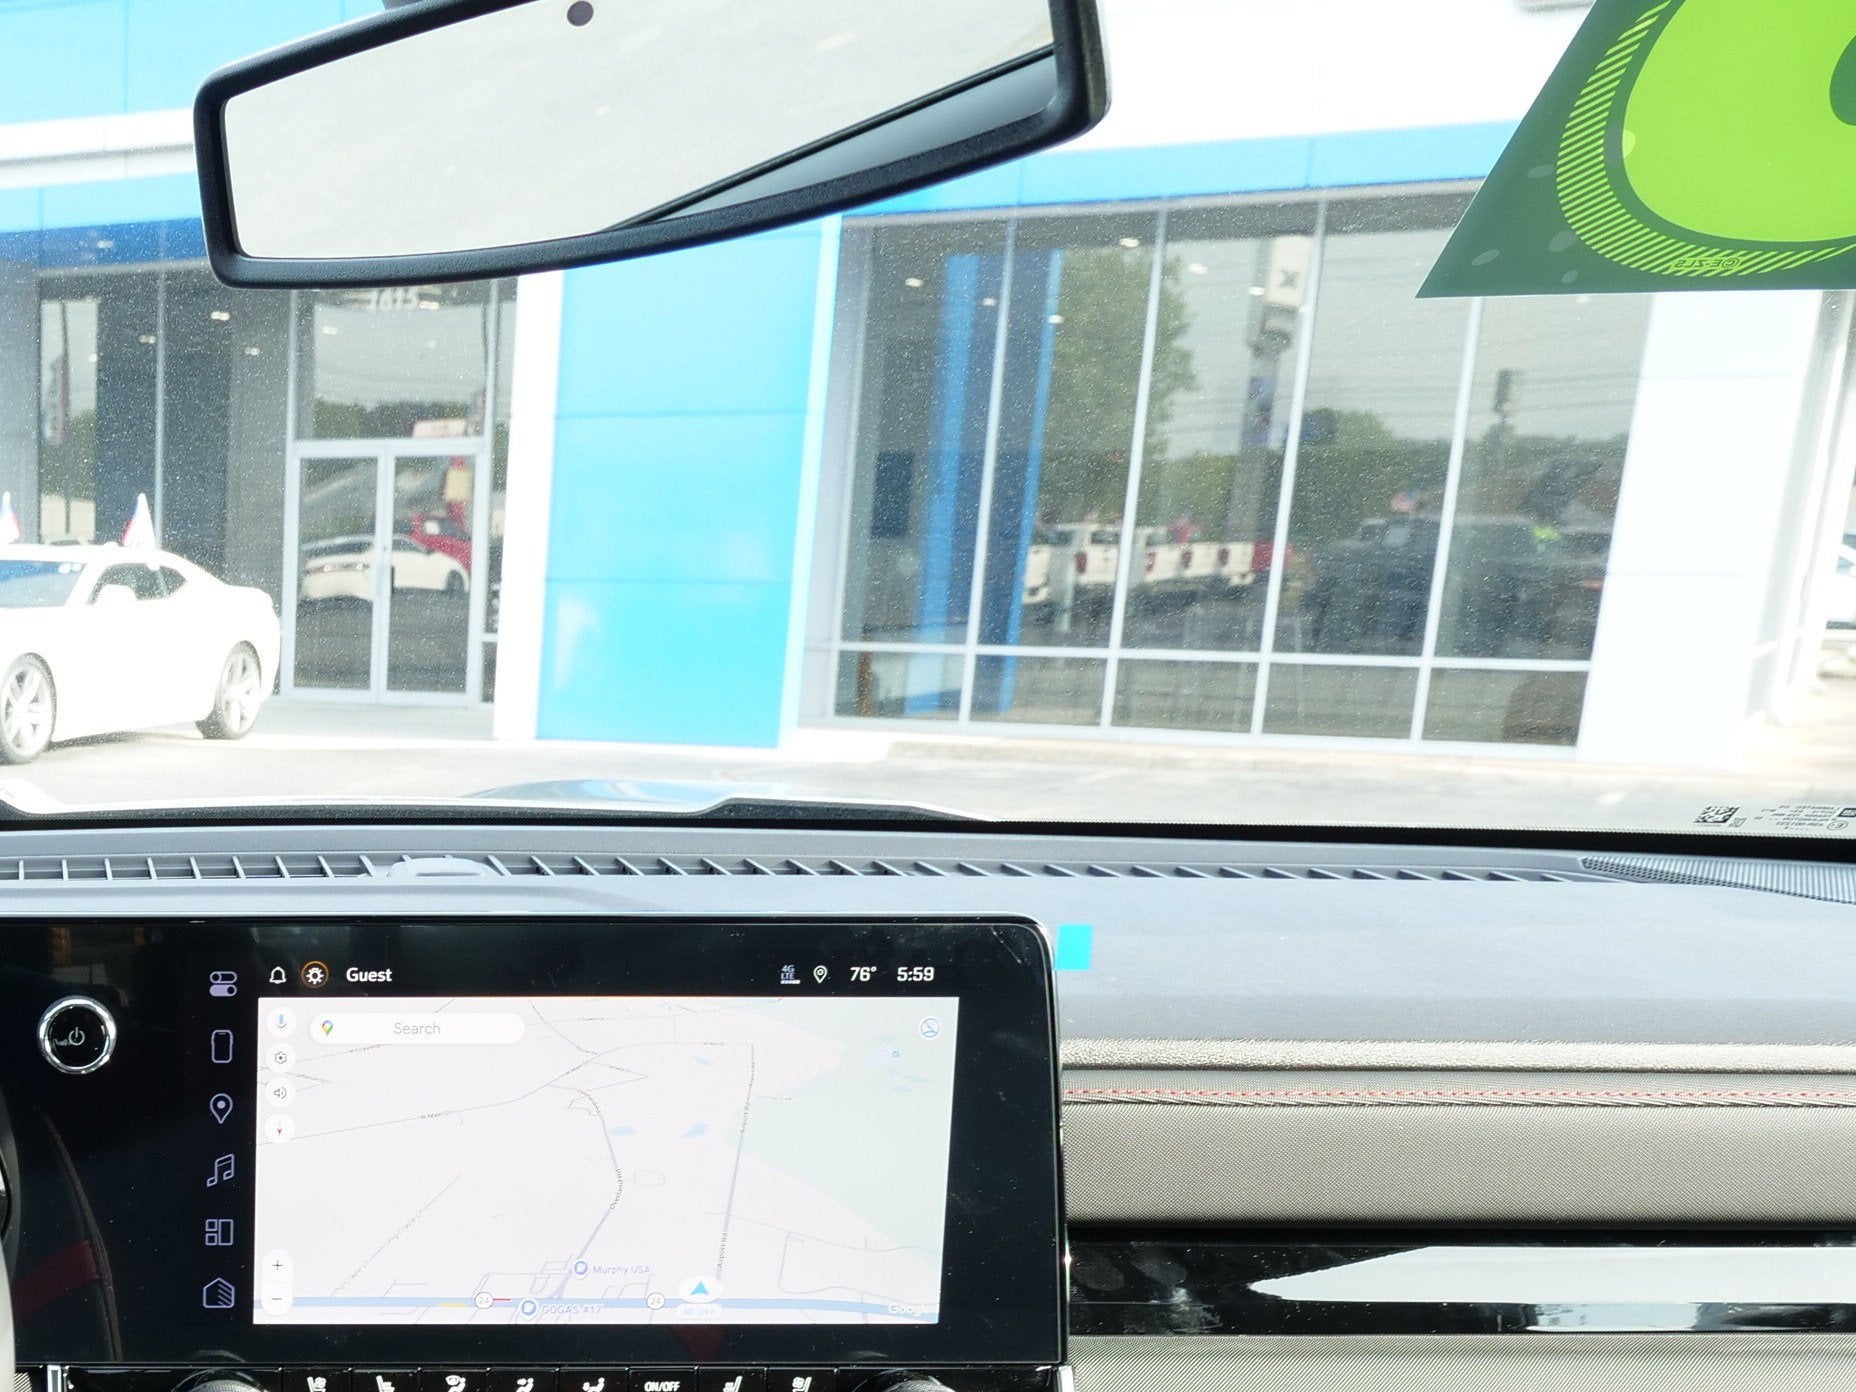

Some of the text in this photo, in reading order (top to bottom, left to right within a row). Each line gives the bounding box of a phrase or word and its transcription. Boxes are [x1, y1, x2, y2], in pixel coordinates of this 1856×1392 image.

[346, 968, 393, 983] Guest
[897, 966, 935, 982] 5:59
[394, 1022, 441, 1035] Search
[593, 1265, 650, 1275] Murphy USA
[478, 1296, 490, 1305] 24
[650, 1297, 662, 1305] 24
[644, 1381, 681, 1392] ON/OFF
